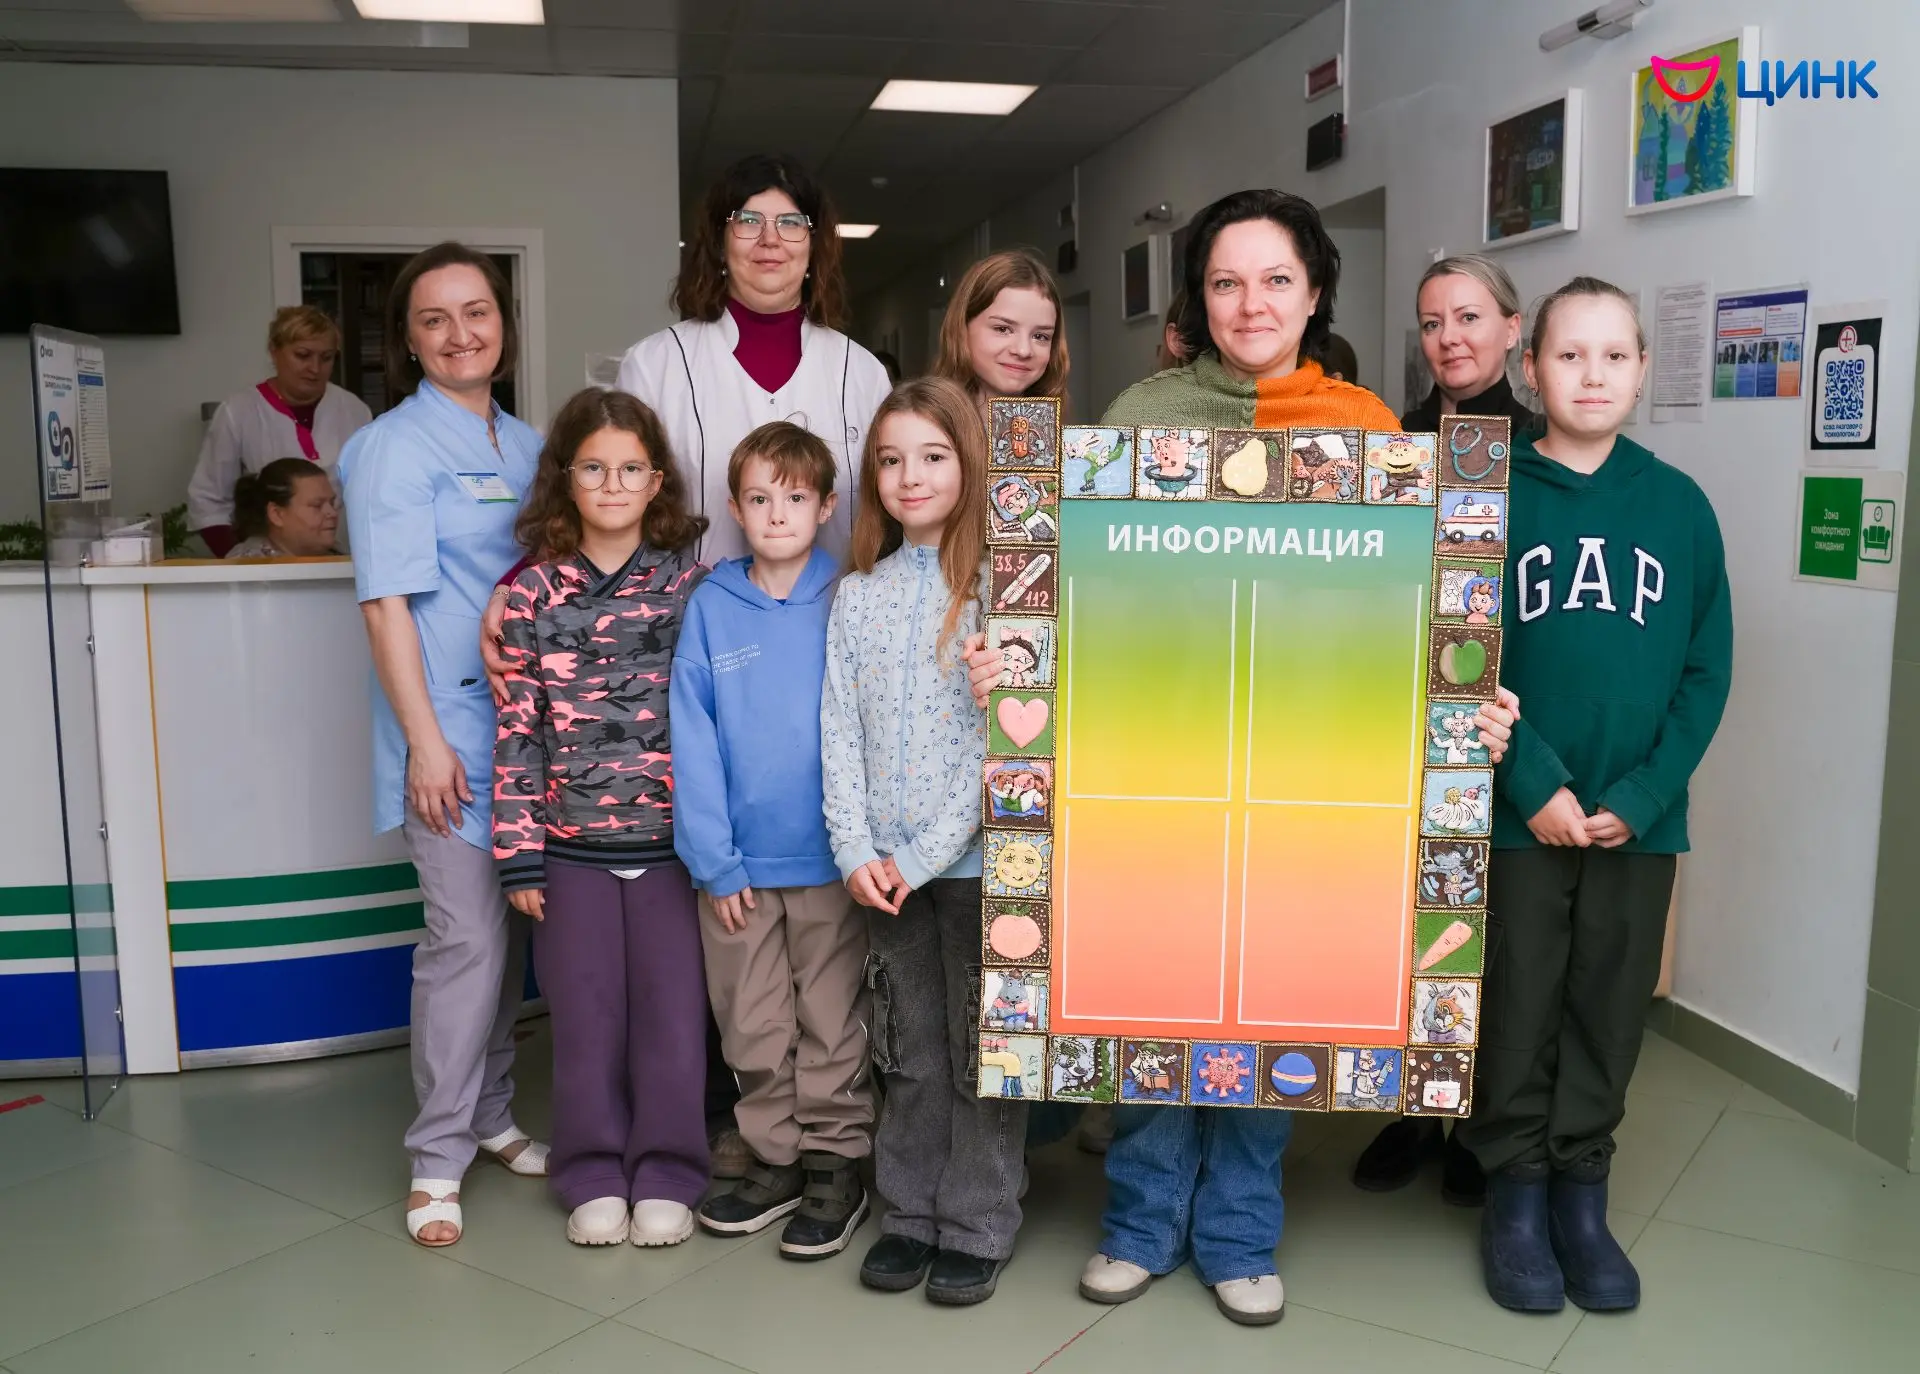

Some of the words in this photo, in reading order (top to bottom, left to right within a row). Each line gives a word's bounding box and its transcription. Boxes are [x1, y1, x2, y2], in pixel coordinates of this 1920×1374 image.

[1823, 508, 1839, 521] Зона
[1810, 524, 1851, 538] комфортного
[1106, 523, 1385, 562] ИНФОРМАЦИЯ
[994, 553, 1028, 575] 38,5
[1516, 536, 1665, 627] GAP
[1024, 590, 1050, 608] 112
